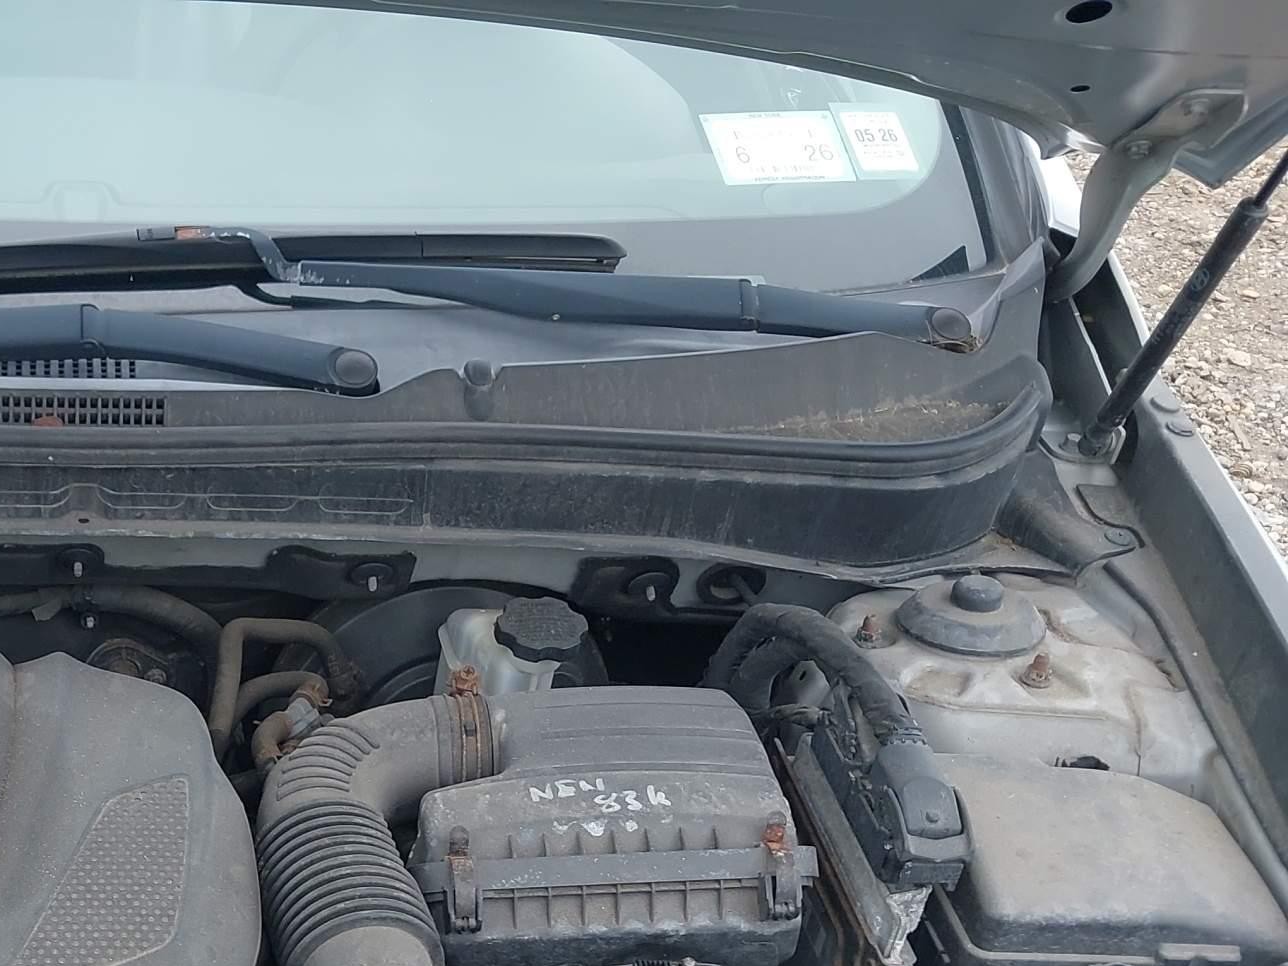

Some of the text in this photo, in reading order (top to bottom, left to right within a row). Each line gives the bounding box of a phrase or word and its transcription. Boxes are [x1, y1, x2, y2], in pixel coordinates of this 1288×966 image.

[854, 127, 898, 143] 05 26
[735, 143, 834, 164] 6 26
